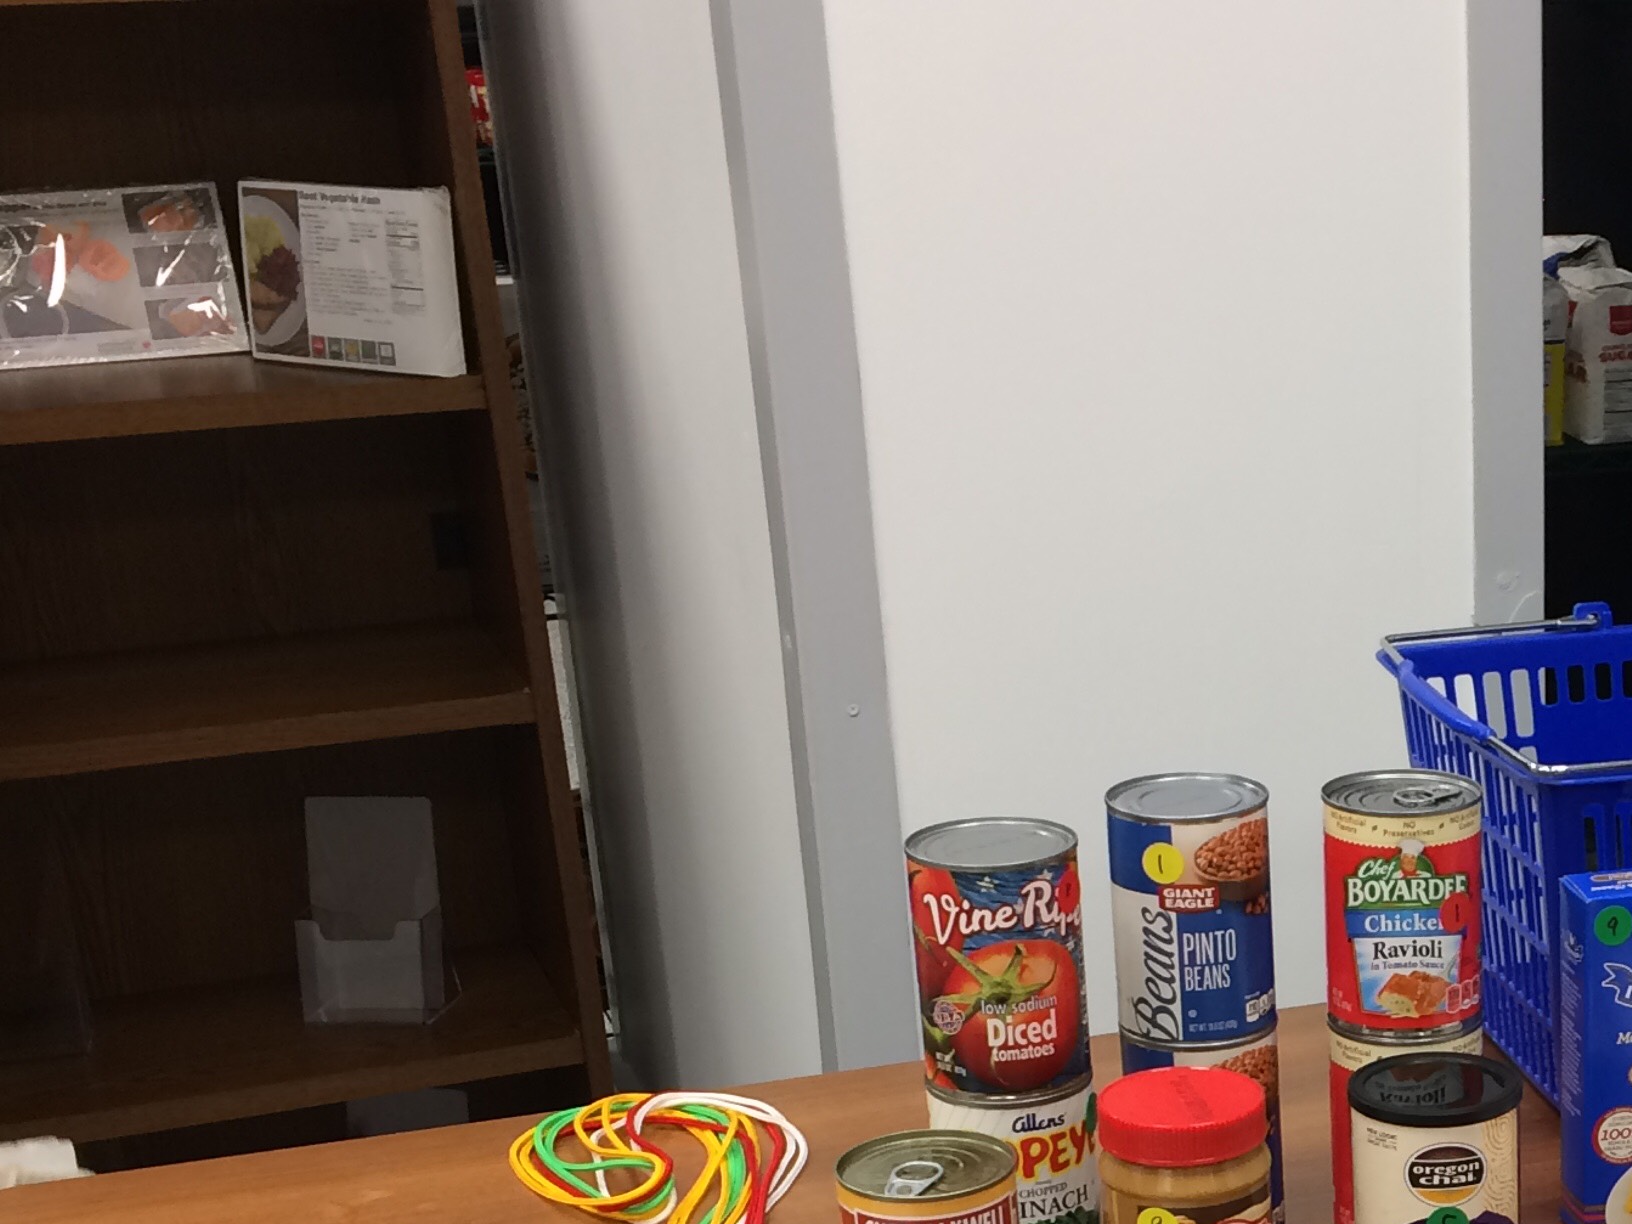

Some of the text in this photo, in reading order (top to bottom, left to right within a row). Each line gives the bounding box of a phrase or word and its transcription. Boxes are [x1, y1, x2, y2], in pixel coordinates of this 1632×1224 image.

[1358, 858, 1397, 881] Chef
[1162, 886, 1217, 900] GIANT
[1165, 897, 1216, 910] EAGLE
[923, 893, 1018, 946] Vine
[1364, 912, 1446, 933] Chicke
[1182, 929, 1237, 966] PINTO
[1372, 939, 1443, 961] Ravioli
[1127, 906, 1180, 1041] Beans
[1382, 961, 1418, 971] Tomato
[1420, 960, 1445, 970] Sauce
[1185, 963, 1231, 992] BEANS
[981, 995, 1058, 1015] low sodium
[986, 1008, 1058, 1047] Diced
[992, 1042, 1056, 1063] tomatoes
[1412, 1160, 1480, 1177] oregon
[1018, 1181, 1068, 1199] CHOPPED
